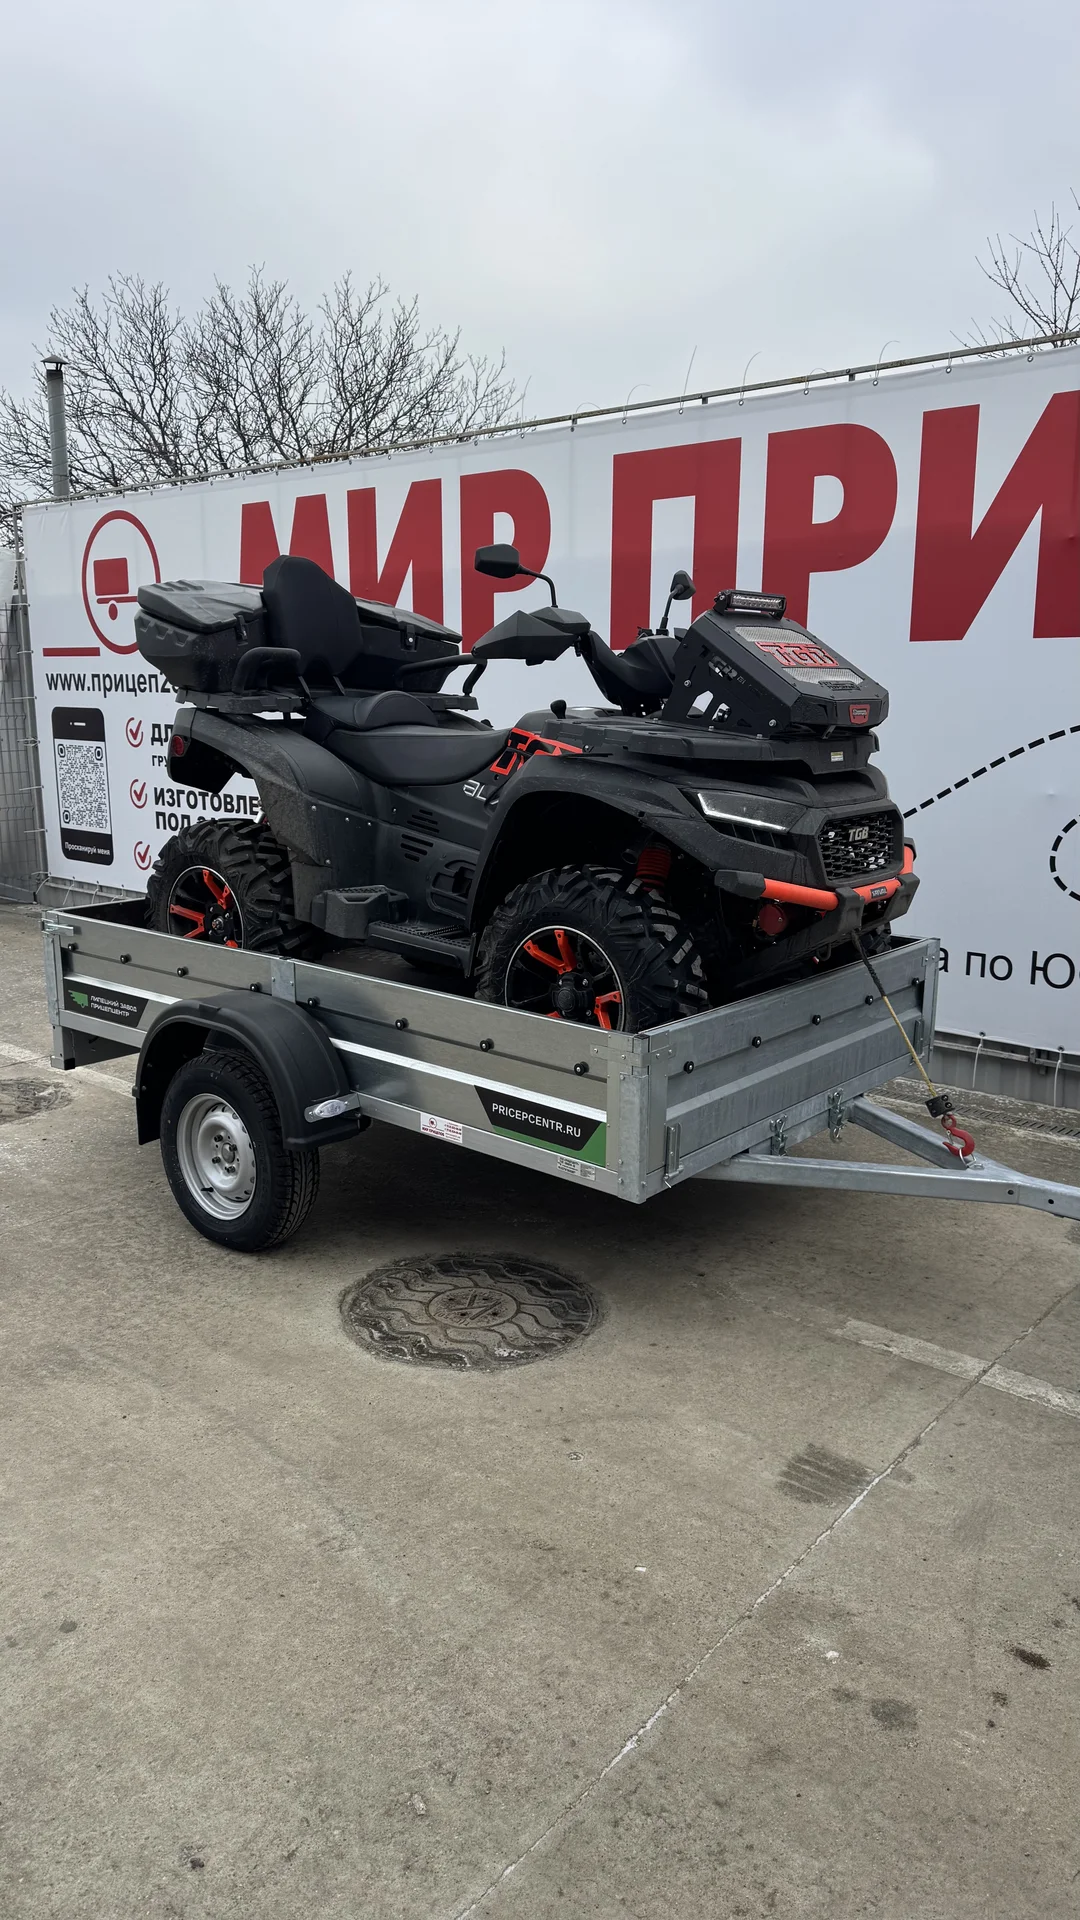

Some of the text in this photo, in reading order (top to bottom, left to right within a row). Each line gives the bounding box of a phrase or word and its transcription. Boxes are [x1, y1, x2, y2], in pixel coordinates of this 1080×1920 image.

[240, 469, 552, 651] МИР
[755, 641, 839, 667] TGB
[154, 787, 259, 815] ИЗГОТОВЛЕ
[848, 826, 869, 842] TGB
[64, 841, 111, 856] Просканируй меня
[966, 951, 1013, 981] по
[1030, 950, 1080, 989] Ю
[90, 1003, 130, 1017] ПРИЦЕПЦЕНТР
[120, 1003, 137, 1012] ЗАВОД
[492, 1103, 581, 1138] PRICEPCENTR.RU
